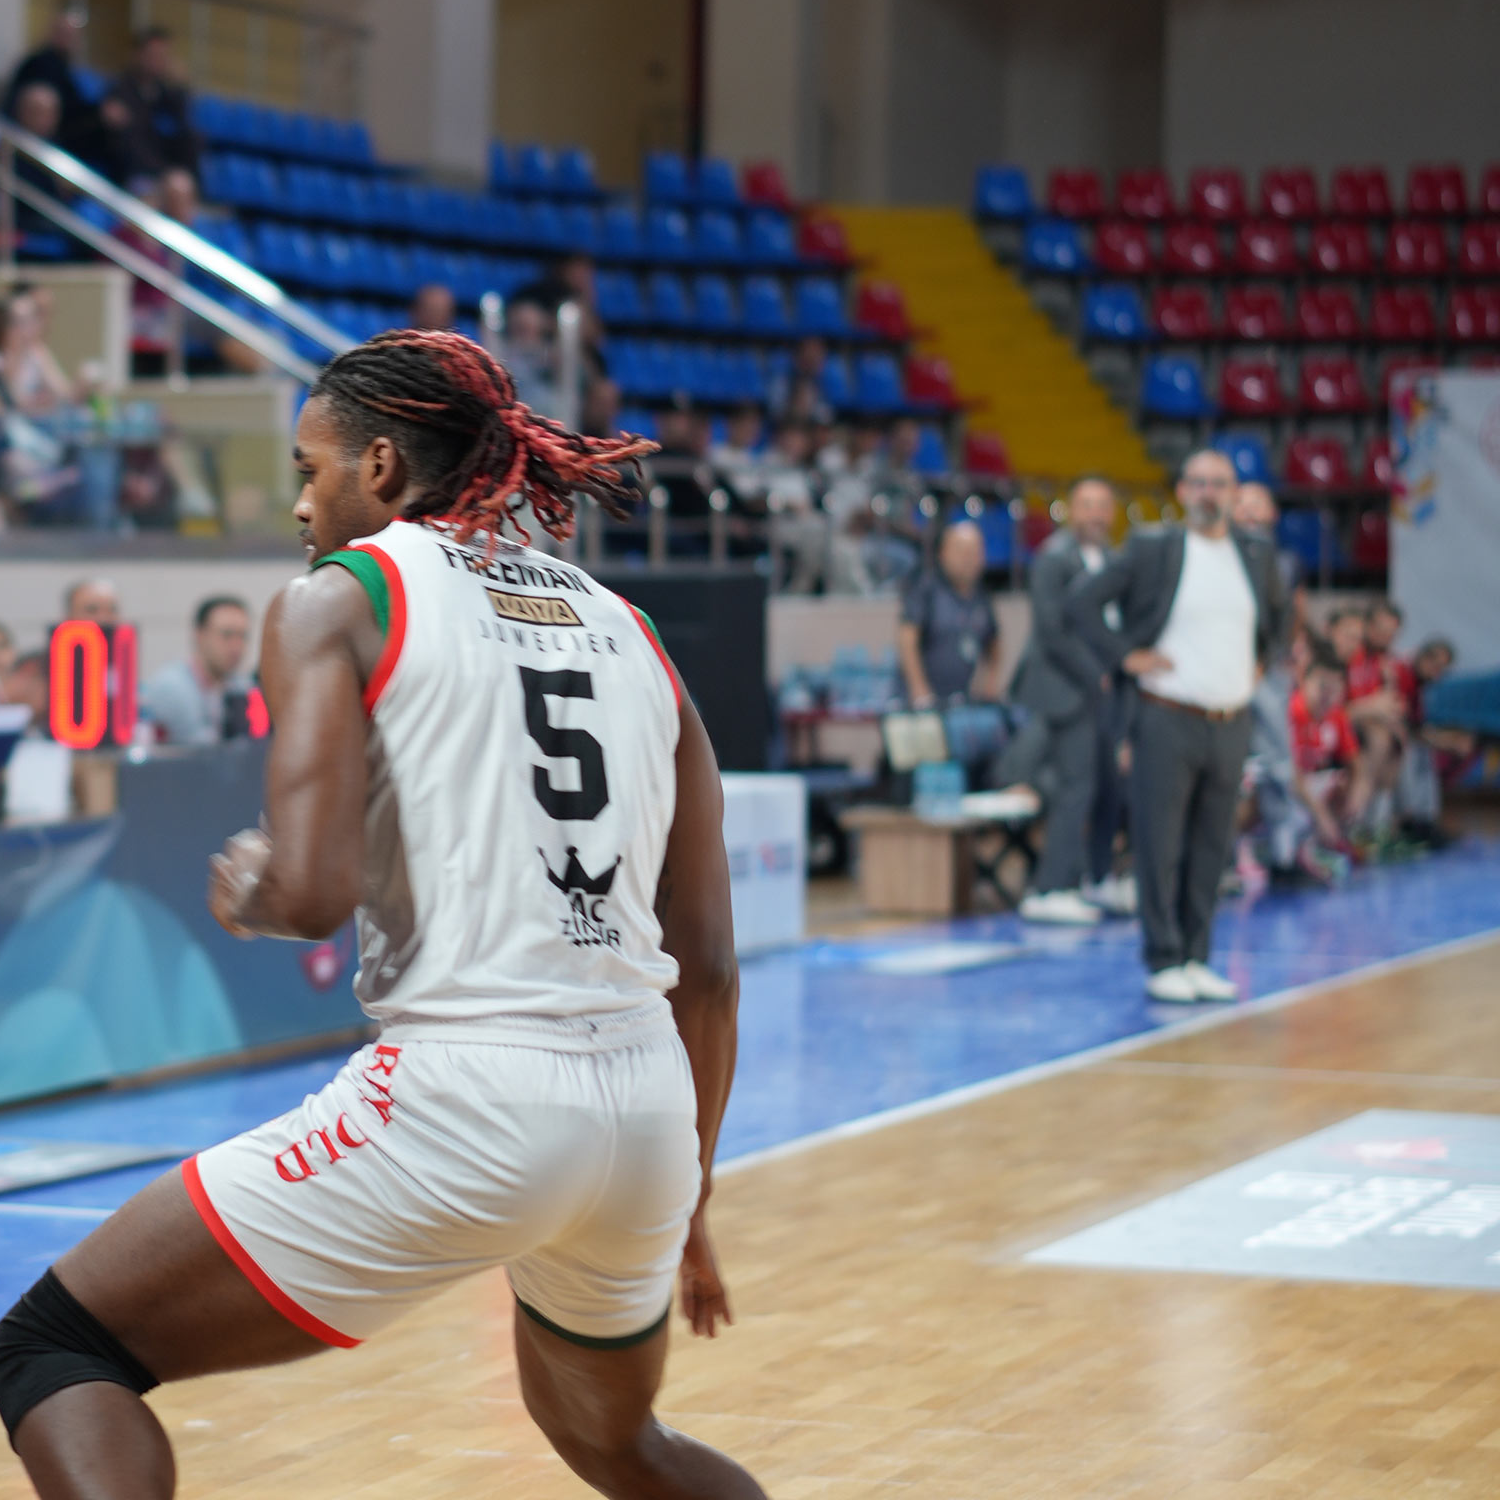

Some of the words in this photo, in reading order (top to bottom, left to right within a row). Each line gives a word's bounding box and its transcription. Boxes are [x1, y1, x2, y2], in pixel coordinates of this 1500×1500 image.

[435, 543, 594, 596] FREEMAN
[50, 620, 108, 750] 0
[517, 664, 610, 820] 5
